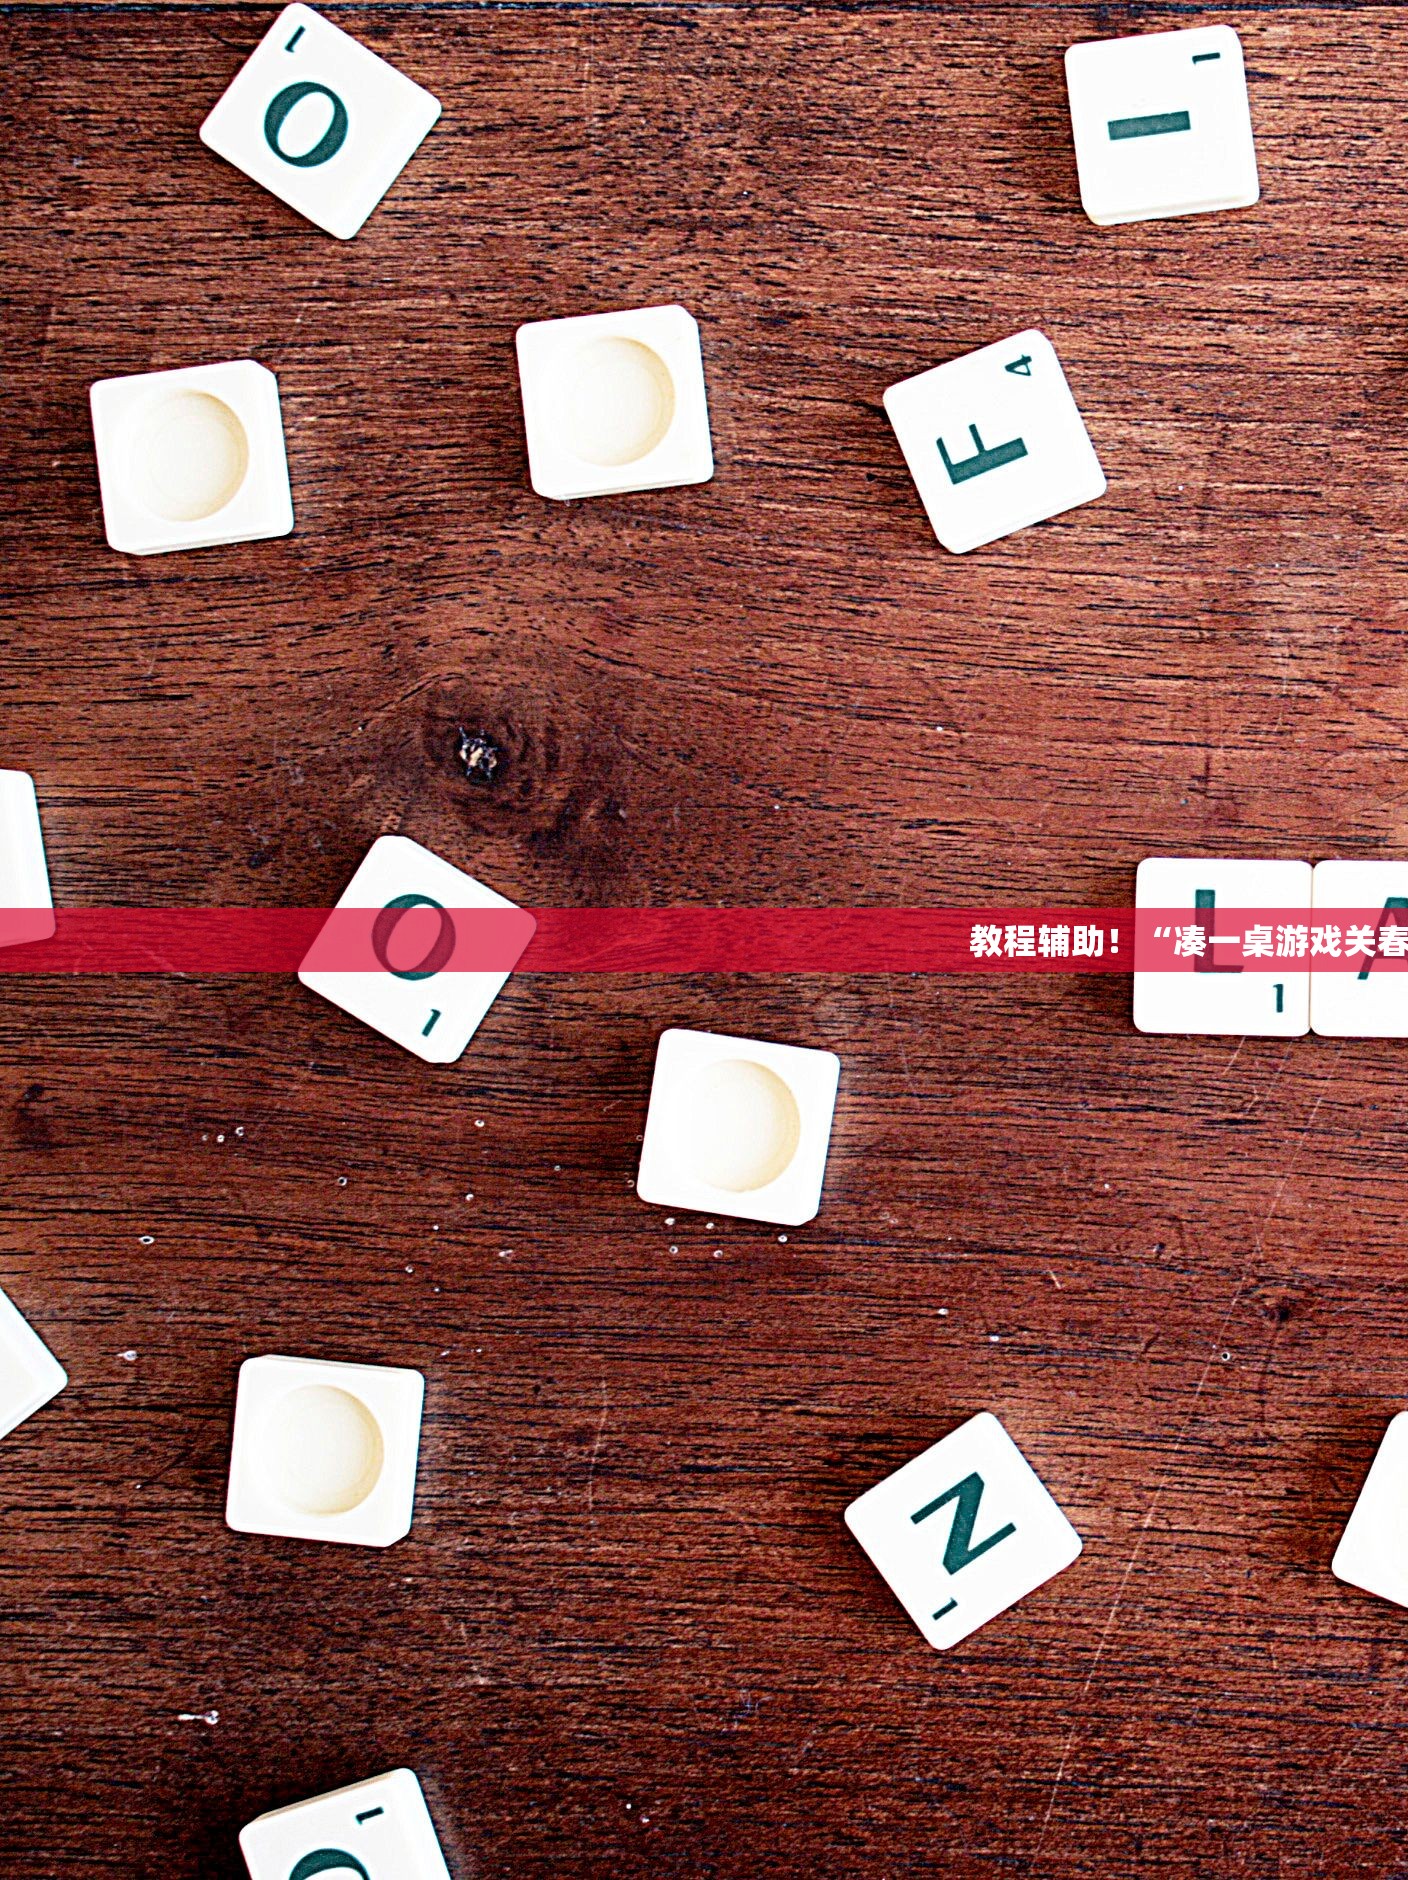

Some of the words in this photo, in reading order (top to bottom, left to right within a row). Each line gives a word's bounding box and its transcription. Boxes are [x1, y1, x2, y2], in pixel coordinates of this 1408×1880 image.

[284, 25, 305, 53] 1
[1192, 52, 1220, 64] 1
[264, 81, 348, 168] O
[1107, 111, 1191, 140] I
[1005, 354, 1032, 376] 4
[936, 424, 1028, 485] F
[371, 894, 456, 981] O
[1273, 984, 1283, 1013] 1
[422, 1009, 441, 1037] 1
[911, 1472, 1016, 1575] N
[932, 1598, 958, 1620] 1
[355, 1807, 384, 1825] 1
